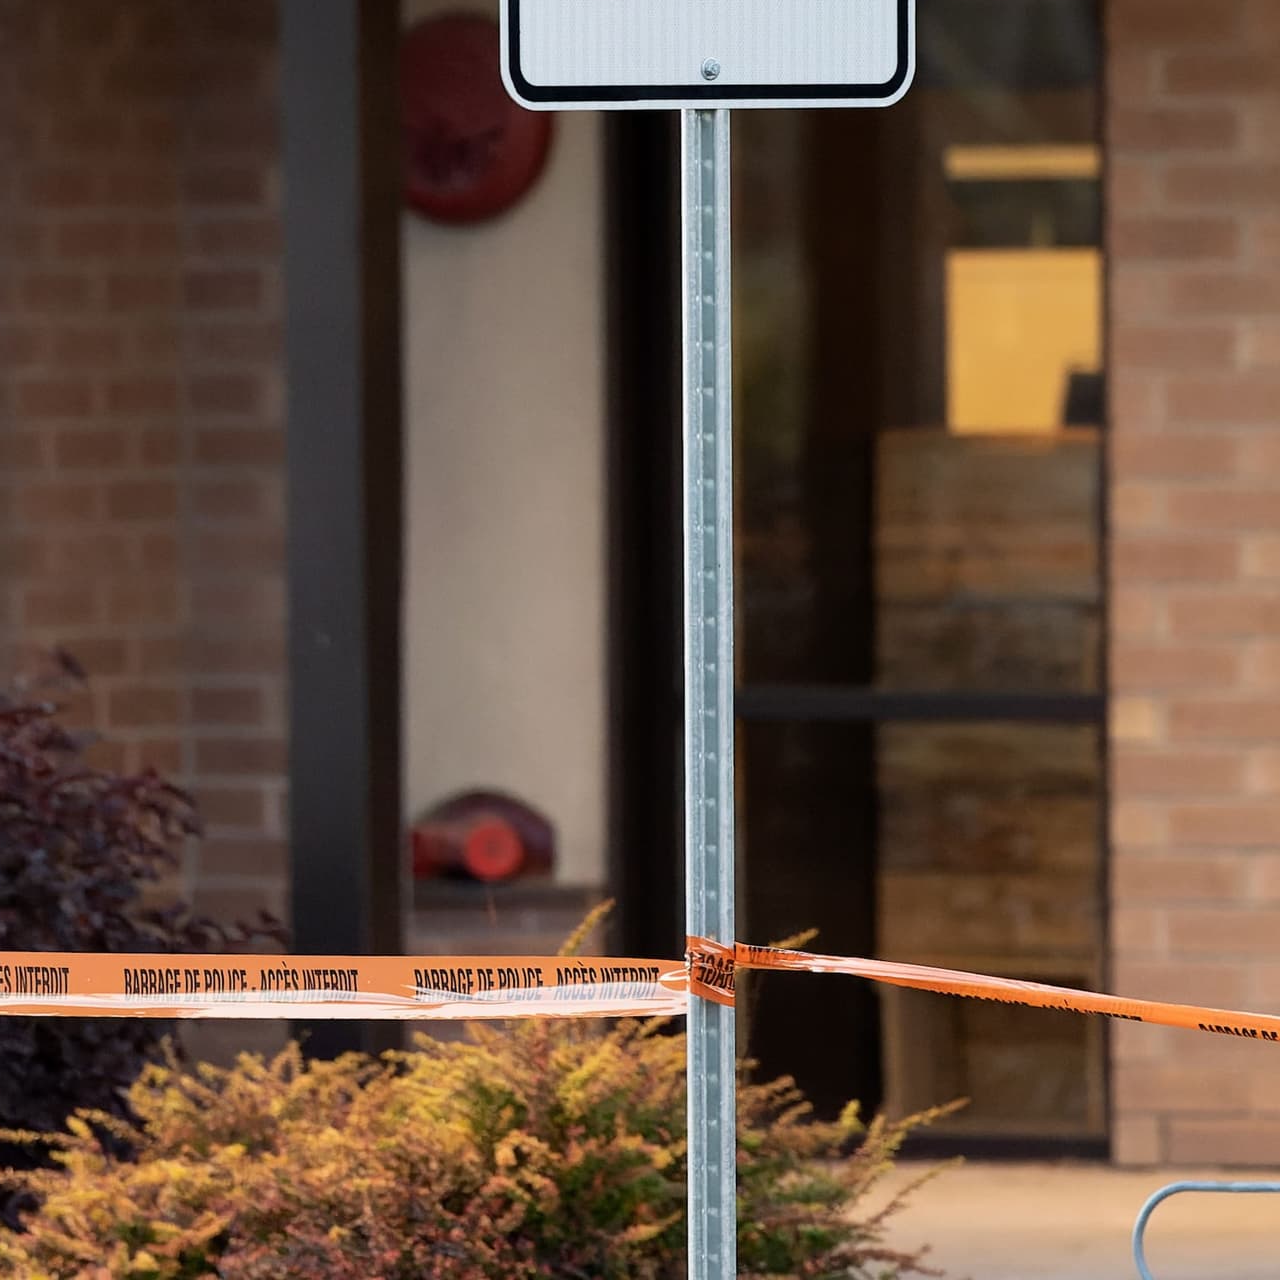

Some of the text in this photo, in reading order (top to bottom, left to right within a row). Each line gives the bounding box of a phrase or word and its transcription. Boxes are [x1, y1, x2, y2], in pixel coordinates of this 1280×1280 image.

[14, 966, 70, 998] INTERDIT
[124, 968, 181, 1001] BARRAGE
[184, 968, 201, 1001] DE
[204, 969, 247, 1002] POLICE
[302, 969, 359, 1000] INTERDIT
[414, 968, 473, 1000] BARRAGE
[477, 968, 494, 1000] DE
[497, 968, 543, 1000] POLICE
[600, 967, 659, 999] INTERDIT
